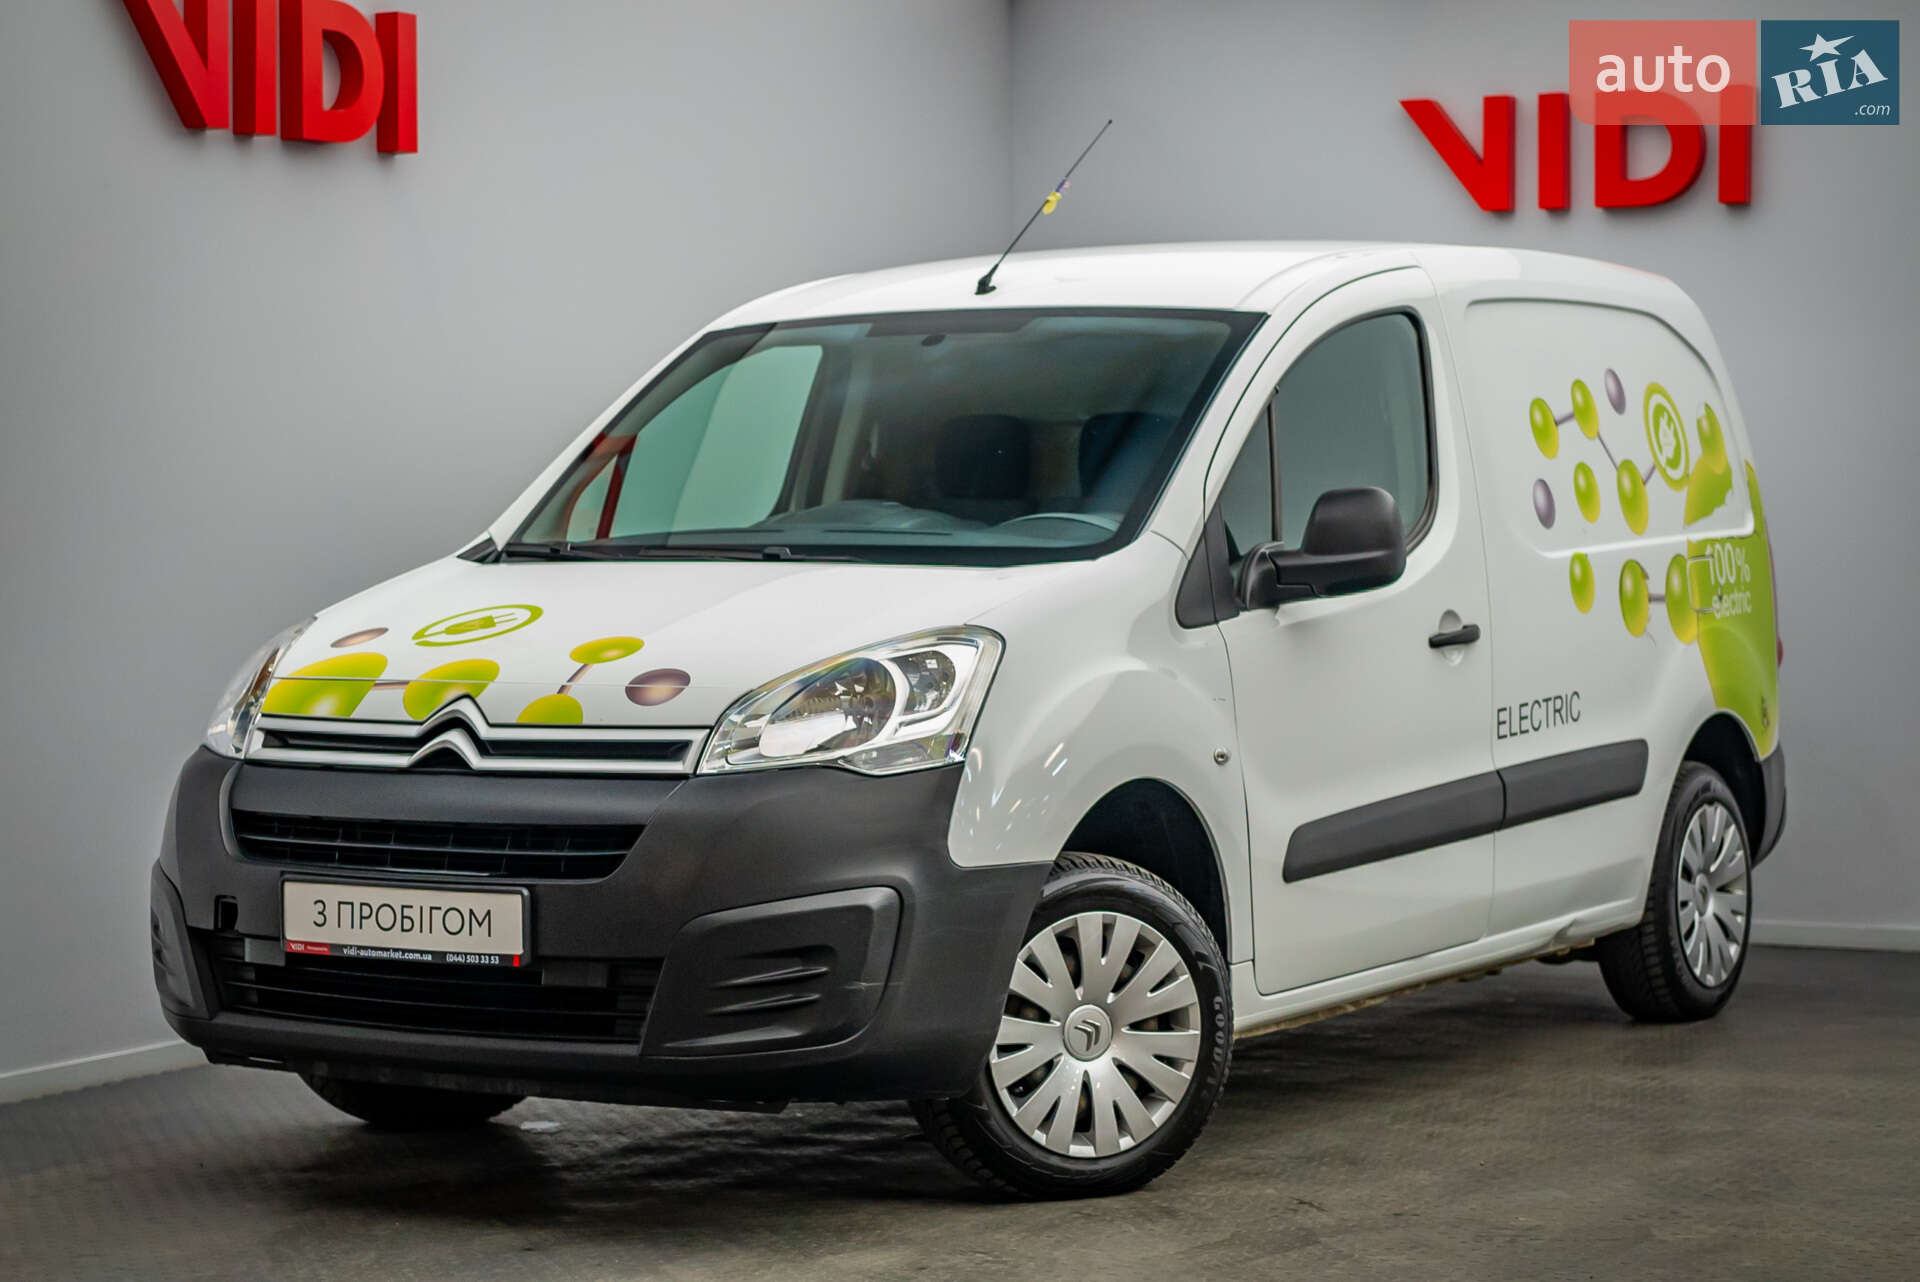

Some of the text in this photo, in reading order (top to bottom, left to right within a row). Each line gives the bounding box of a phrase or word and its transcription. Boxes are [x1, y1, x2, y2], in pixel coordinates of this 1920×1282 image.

[123, 0, 418, 154] VIDI
[1399, 84, 1754, 212] VIDI
[1705, 543, 1751, 585] 100%
[1712, 585, 1752, 619] electric
[1497, 690, 1581, 740] ELECTRIC
[313, 899, 492, 938] З ПРОБІГОМ
[289, 943, 305, 951] VIDI
[342, 947, 432, 962] vidi-automarket.com.ua
[446, 953, 499, 965] (044) 503 33 53
